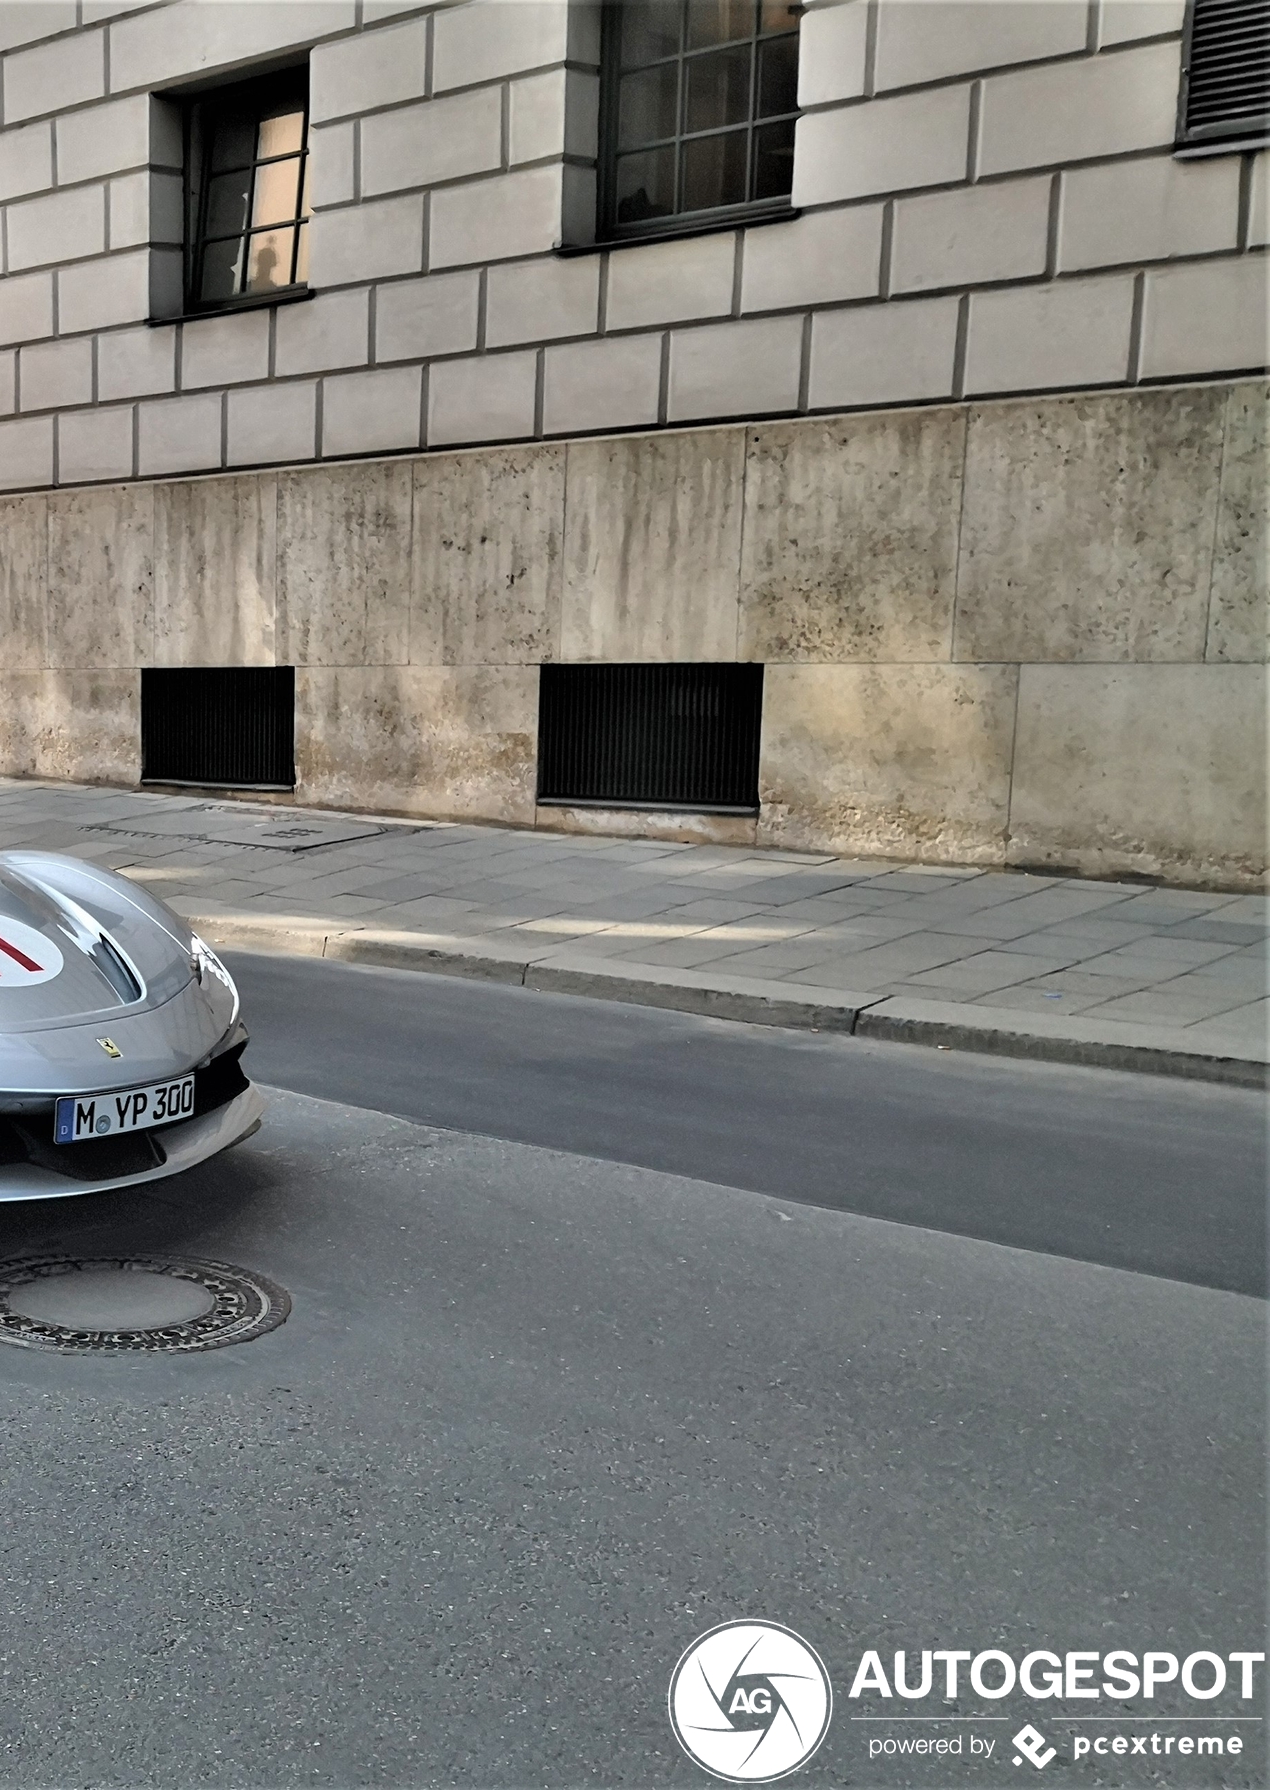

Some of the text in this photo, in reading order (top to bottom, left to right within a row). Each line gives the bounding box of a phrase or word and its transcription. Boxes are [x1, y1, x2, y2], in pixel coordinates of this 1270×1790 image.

[75, 1080, 192, 1135] M YP 300
[60, 1125, 68, 1135] D
